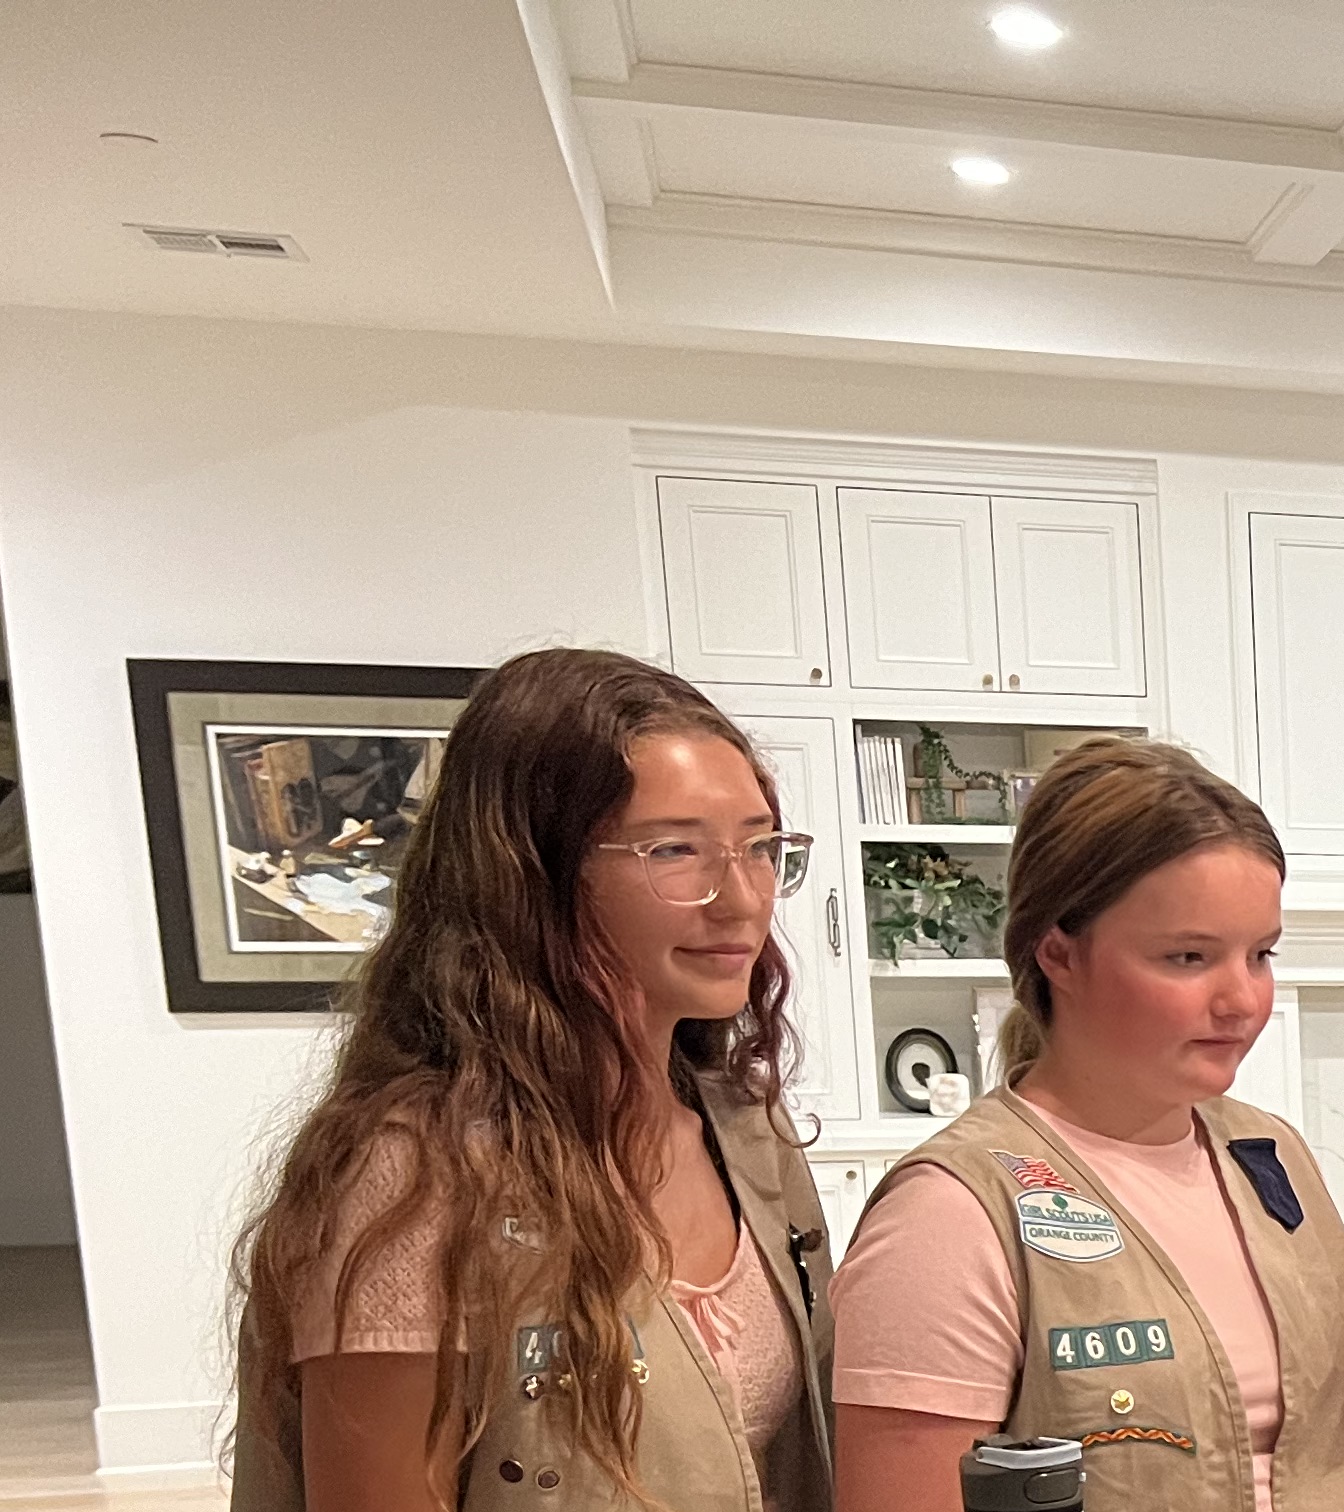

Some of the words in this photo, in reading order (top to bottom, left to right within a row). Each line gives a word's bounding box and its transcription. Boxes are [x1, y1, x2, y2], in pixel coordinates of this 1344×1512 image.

[1046, 1208, 1088, 1224] SCOUTS
[1029, 1227, 1072, 1241] ORANGE
[1073, 1232, 1115, 1243] COUNTY
[1056, 1325, 1167, 1363] 4609
